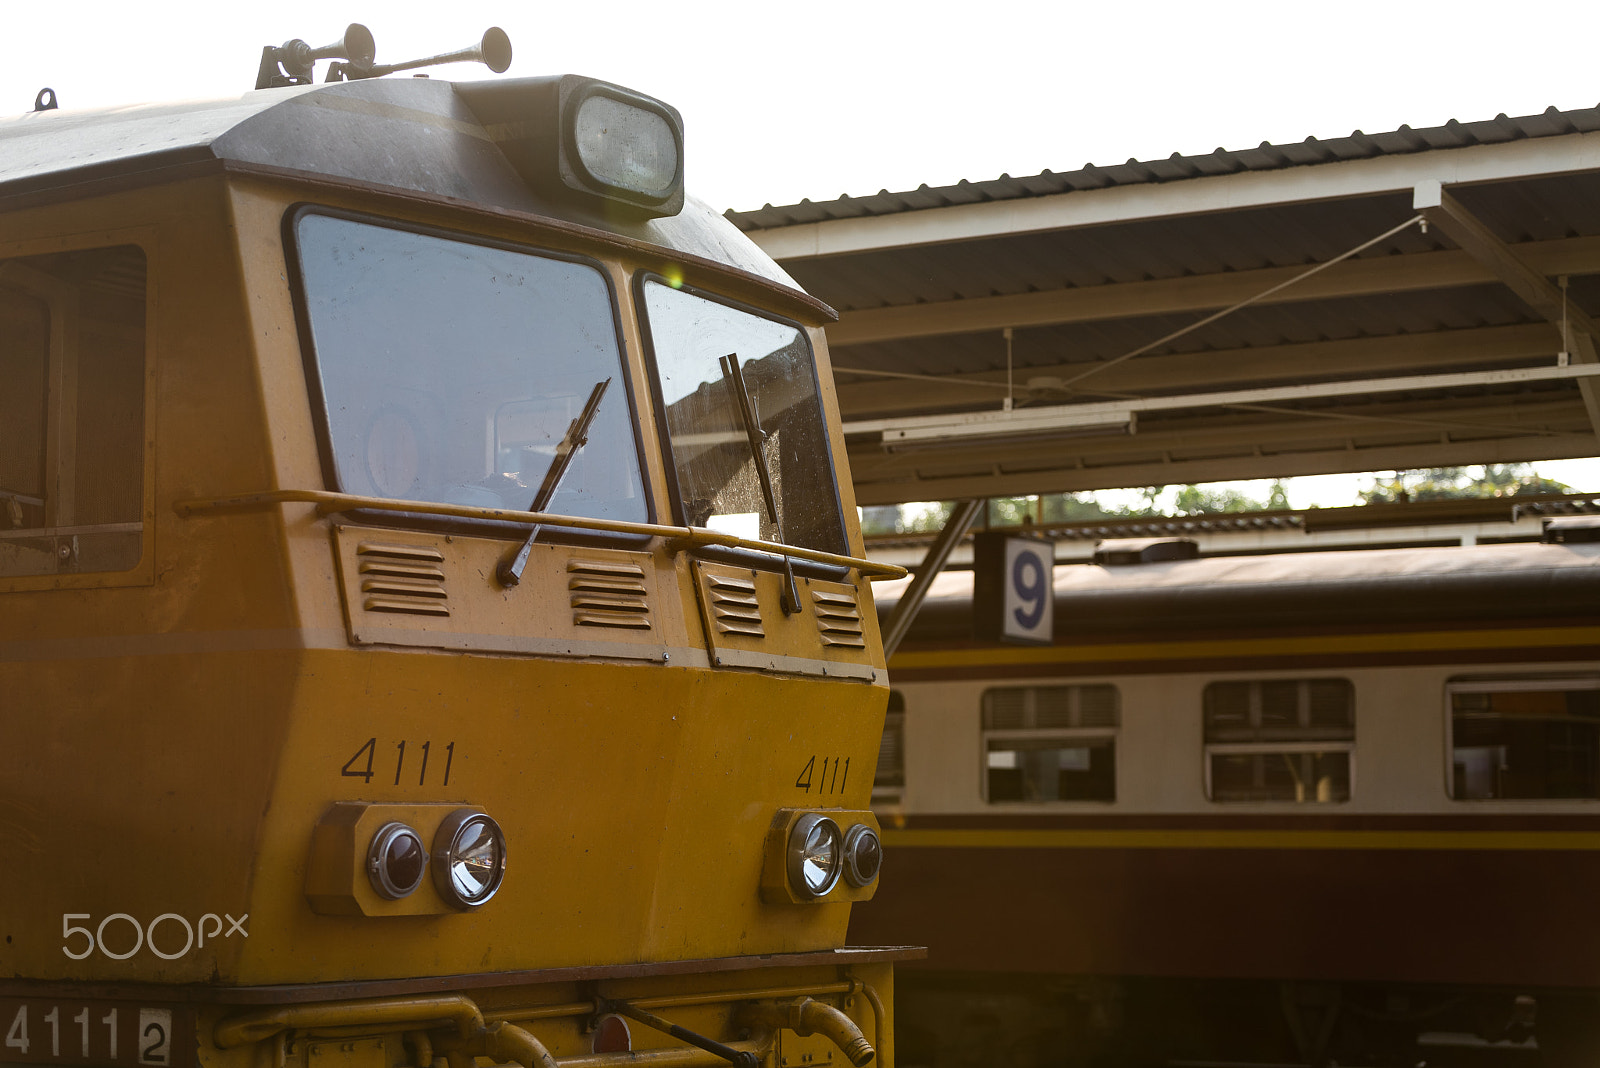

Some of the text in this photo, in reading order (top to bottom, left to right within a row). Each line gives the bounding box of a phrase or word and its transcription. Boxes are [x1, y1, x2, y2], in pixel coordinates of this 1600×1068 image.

[1012, 550, 1046, 631] 9
[341, 737, 455, 786] 4111
[795, 755, 850, 794] 4111
[5, 1005, 166, 1062] 4111 2
